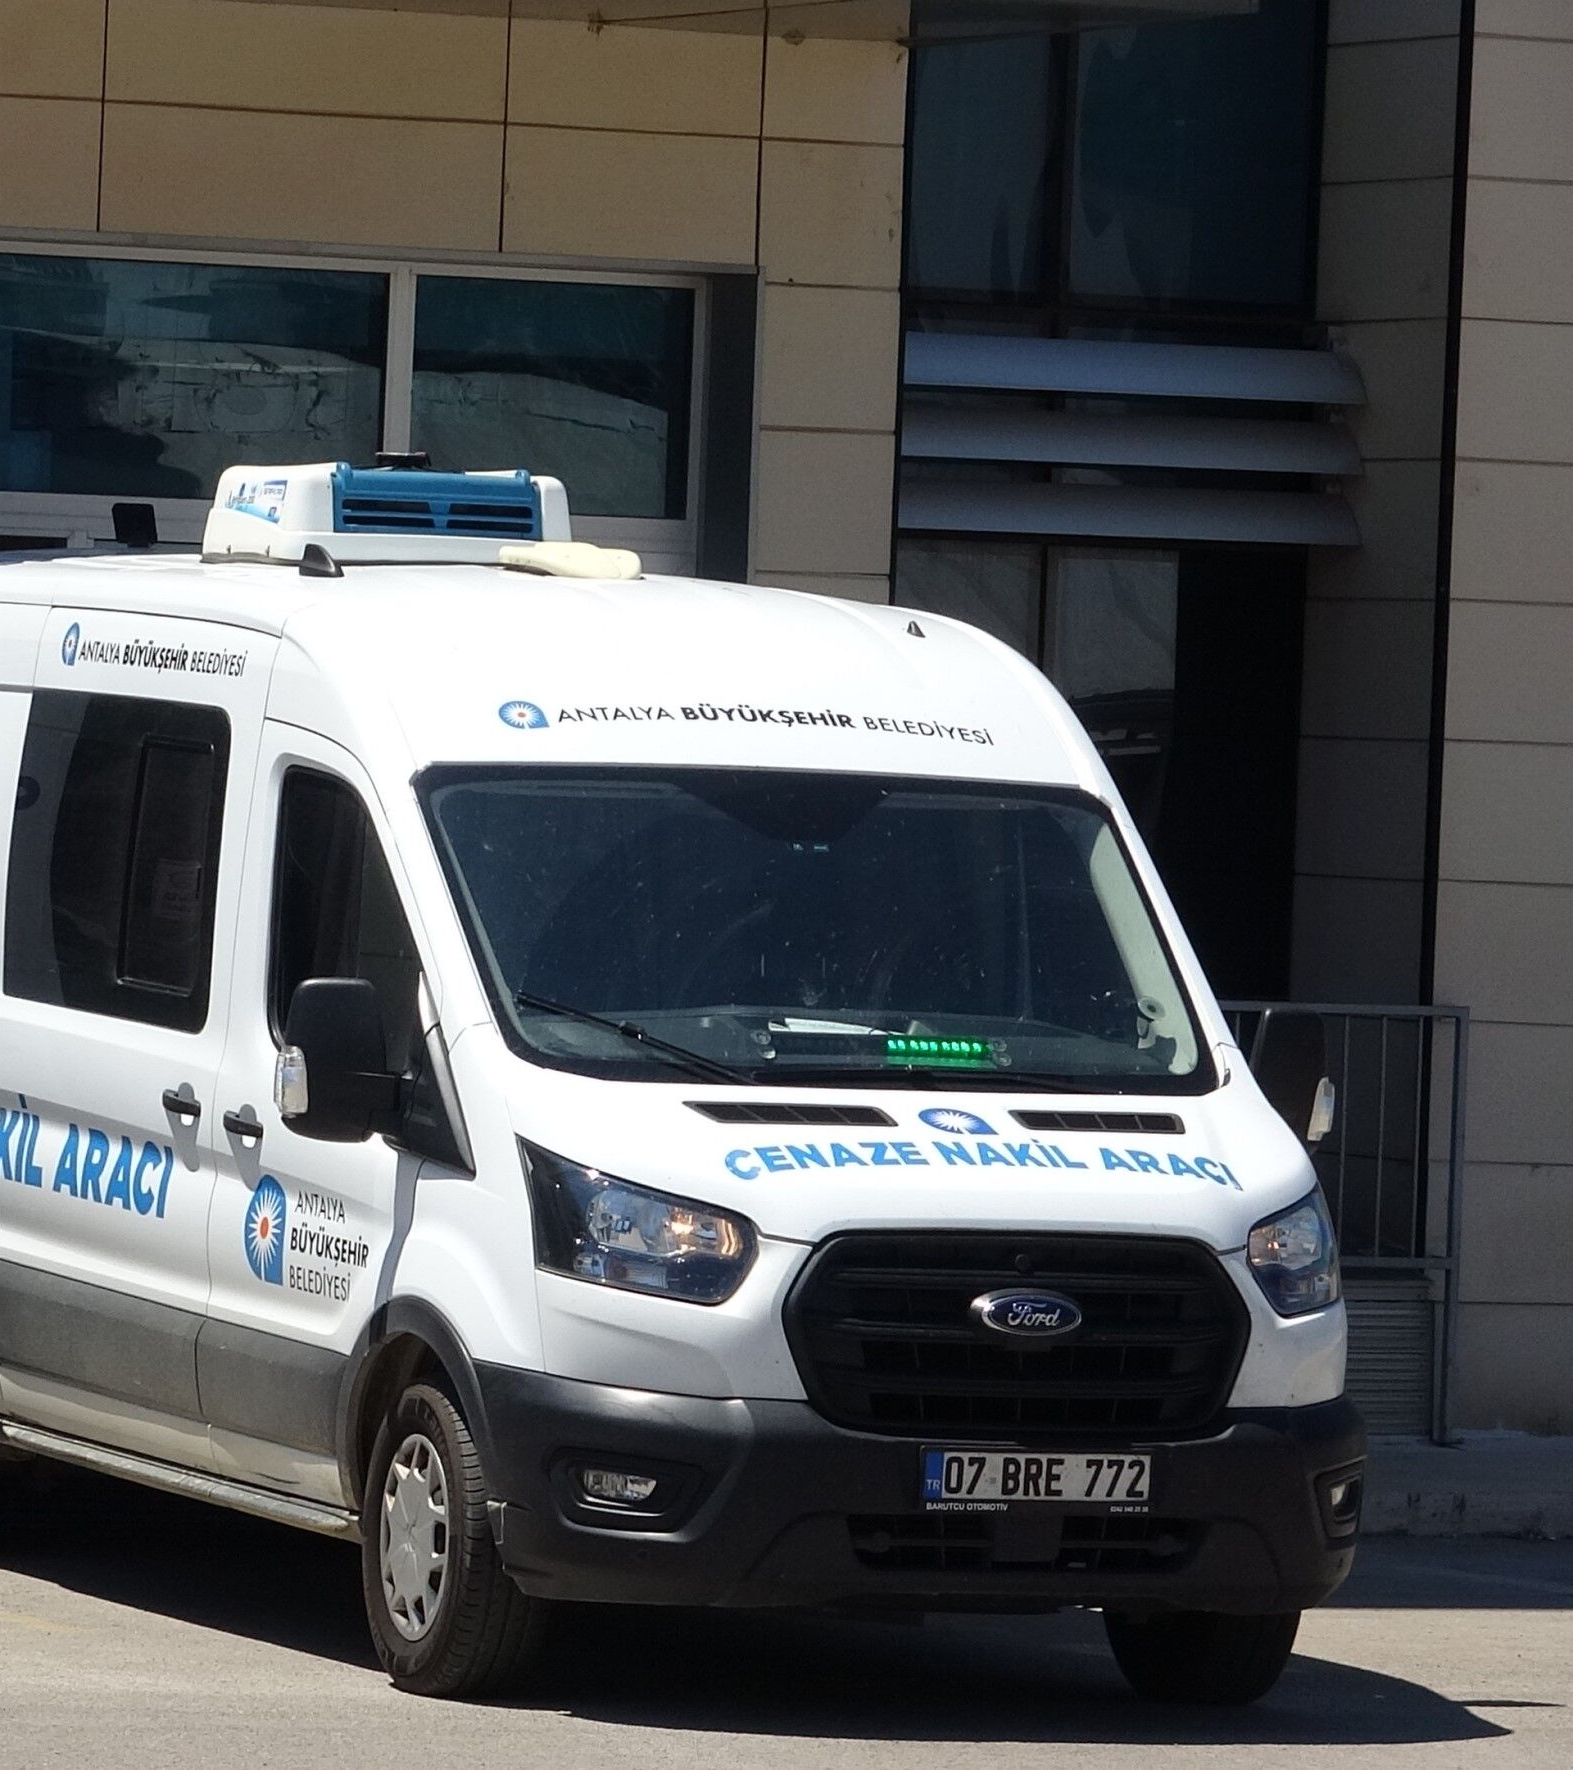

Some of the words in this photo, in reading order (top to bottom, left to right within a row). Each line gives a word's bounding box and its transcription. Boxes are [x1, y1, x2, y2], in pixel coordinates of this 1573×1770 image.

[78, 640, 120, 664] ANTALYA
[122, 639, 189, 674] BÜYÜKŞEHİR
[190, 648, 248, 677] BELEDİYESİ
[558, 706, 675, 723] ANTALYA
[681, 703, 857, 730] BÜYÜKŞEHİR
[863, 716, 994, 746] BELEDİYESİ
[53, 1122, 175, 1219] ARACI
[725, 1141, 928, 1180] CENAZE
[933, 1137, 1089, 1170] NAKİL
[1099, 1148, 1244, 1191] ARACI
[294, 1190, 346, 1224] ANTALYA
[290, 1222, 369, 1269] BÜYÜKŞEHİR
[289, 1264, 351, 1301] BELEDİYESİ
[1007, 1301, 1061, 1327] Ford
[926, 1479, 941, 1491] TR
[944, 1456, 987, 1496] 07
[1000, 1457, 1065, 1498] BRE
[1084, 1458, 1146, 1499] 772
